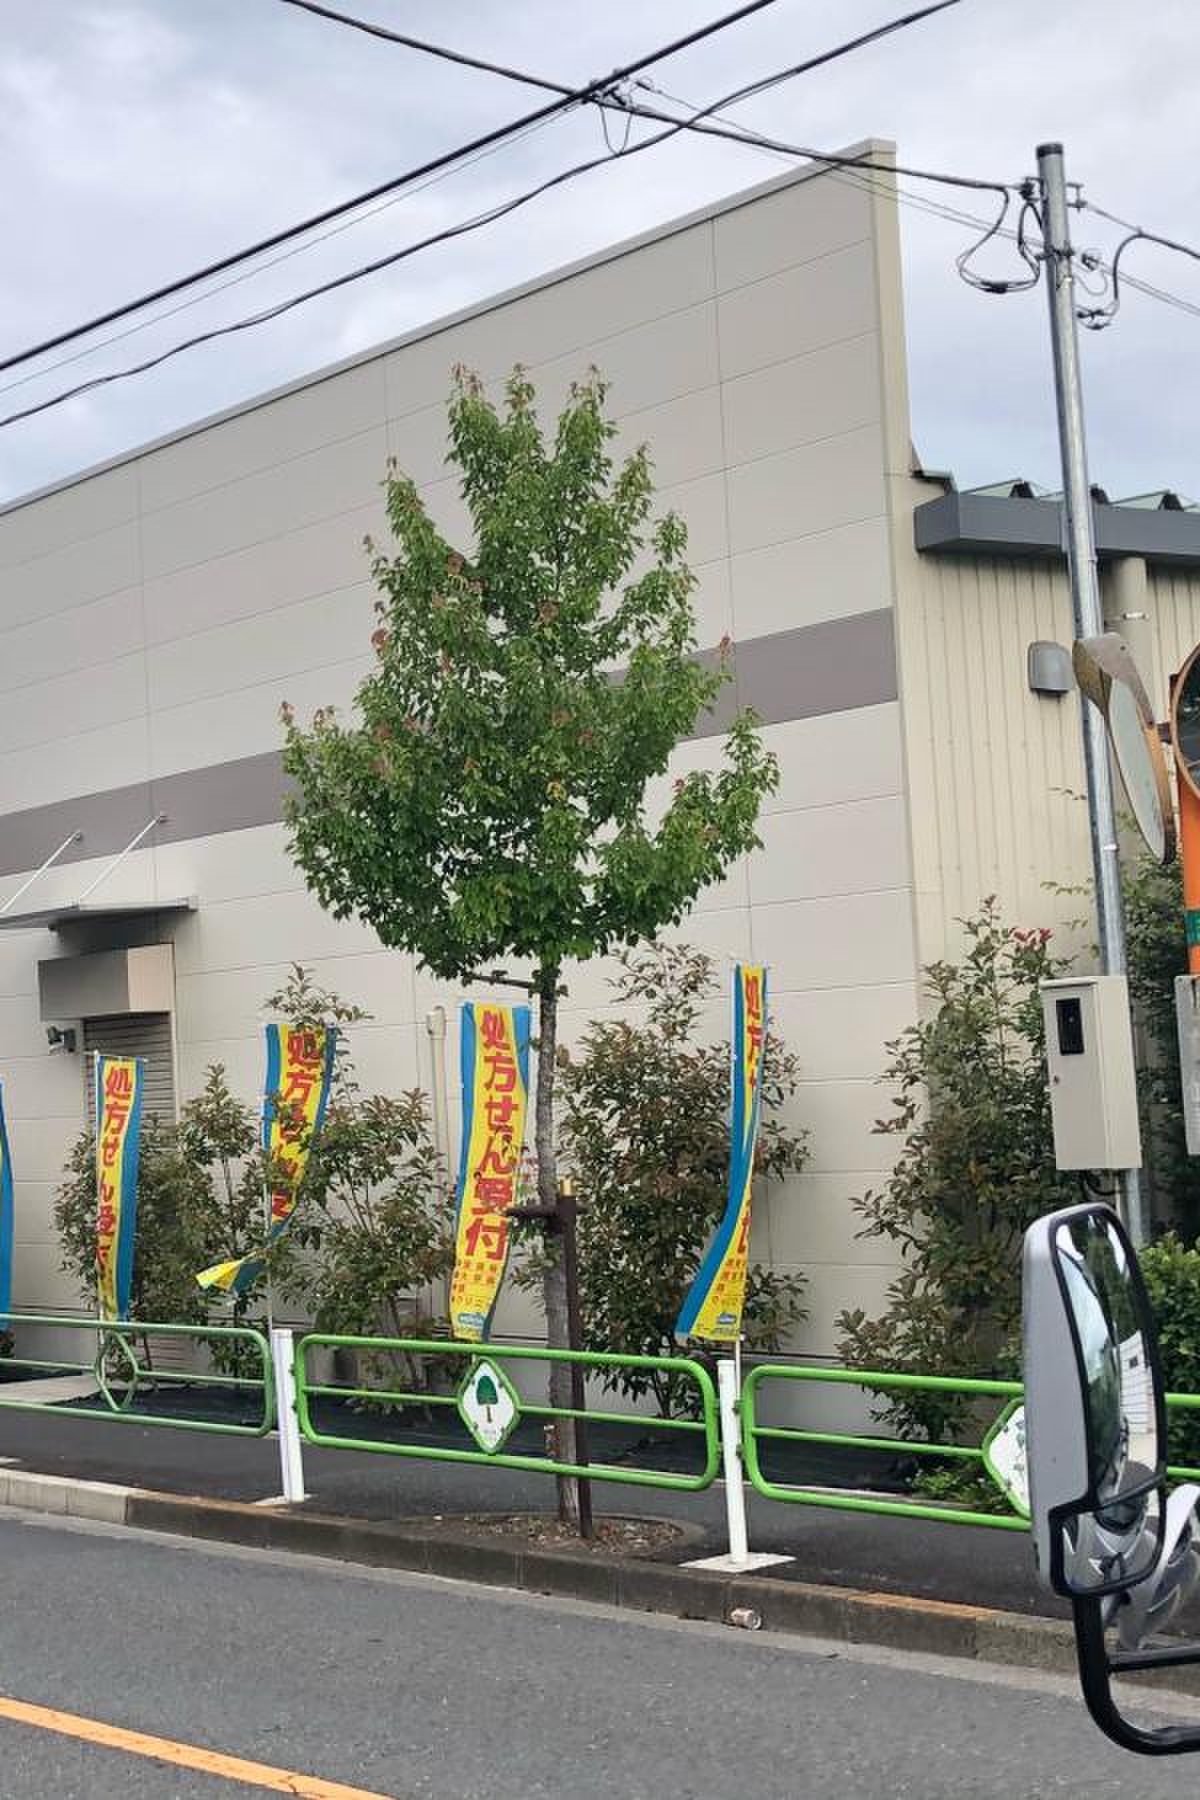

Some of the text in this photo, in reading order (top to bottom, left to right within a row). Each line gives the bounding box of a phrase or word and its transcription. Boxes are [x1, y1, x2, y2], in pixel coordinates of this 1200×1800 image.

[465, 1010, 519, 1261] 処方せん受付
